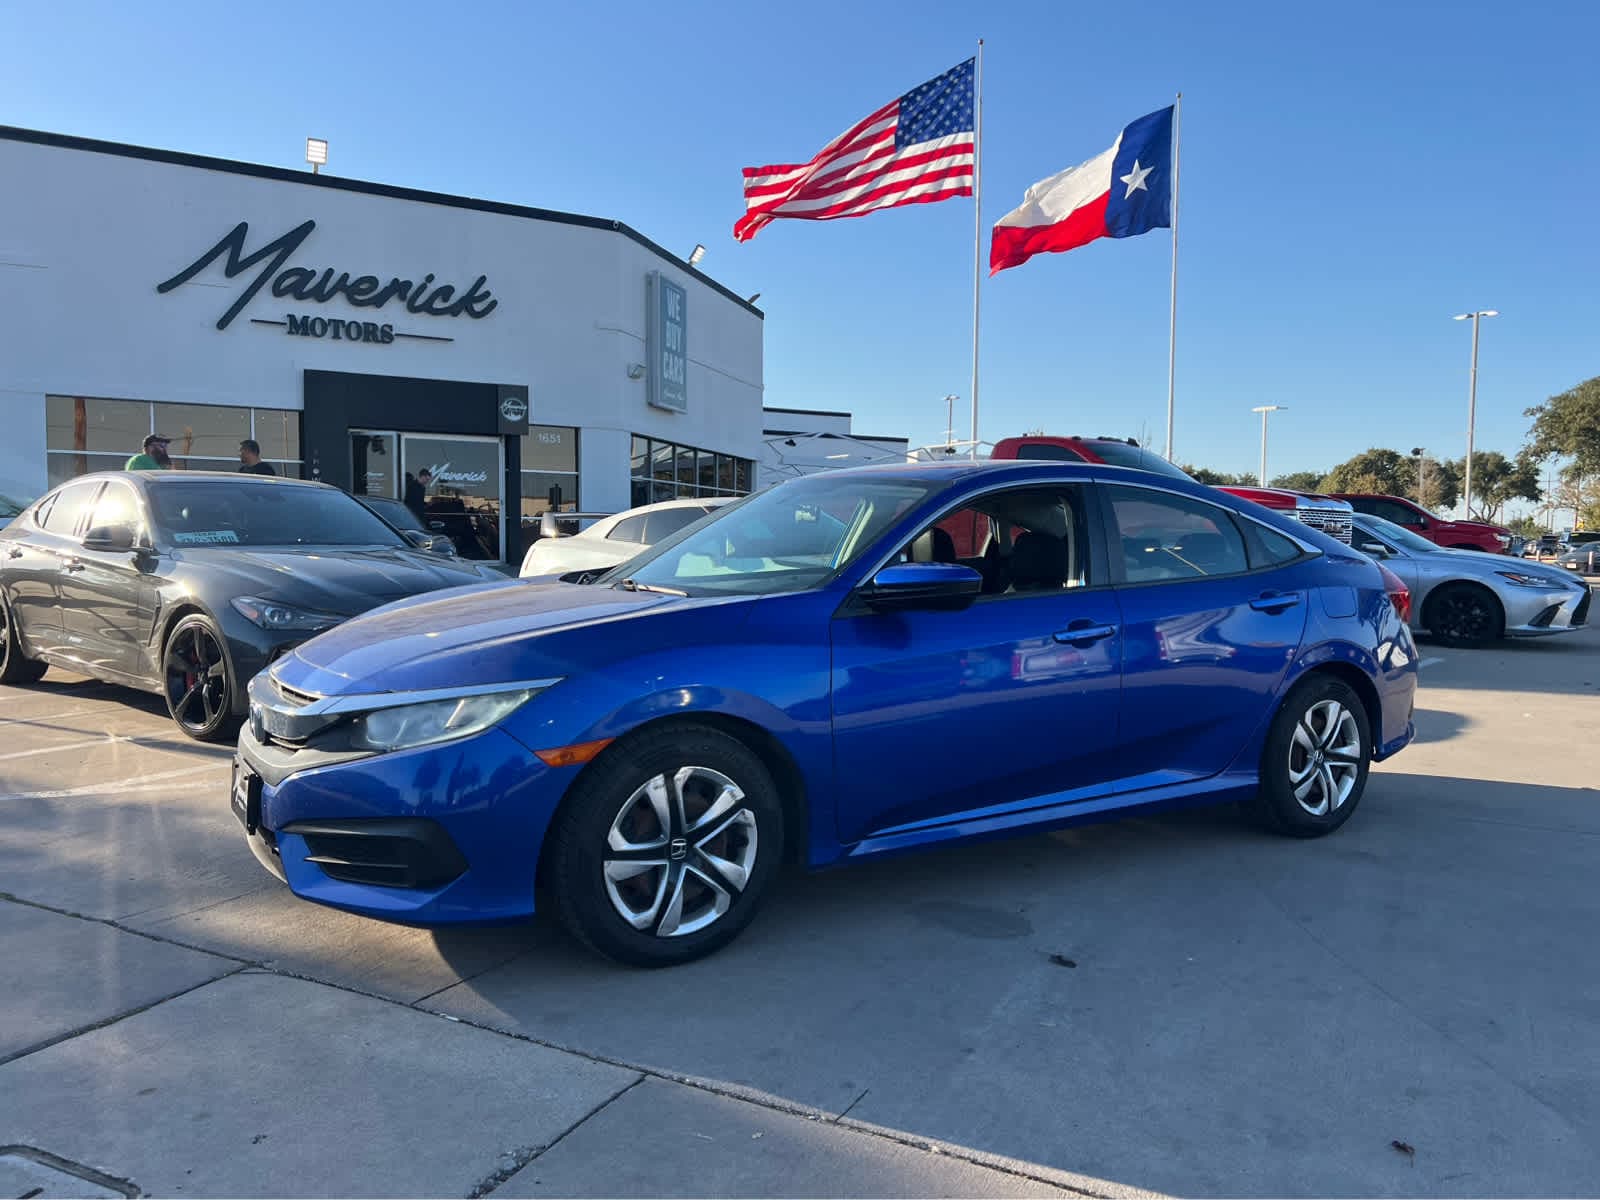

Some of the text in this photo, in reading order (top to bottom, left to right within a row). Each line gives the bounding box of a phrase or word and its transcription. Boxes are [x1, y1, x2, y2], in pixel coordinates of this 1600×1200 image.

[157, 220, 498, 330] Maverick
[666, 286, 681, 321] WE
[286, 314, 394, 344] MOTORS
[665, 320, 682, 353] BUY
[663, 351, 684, 385] CARS
[429, 462, 488, 488] Maverick
